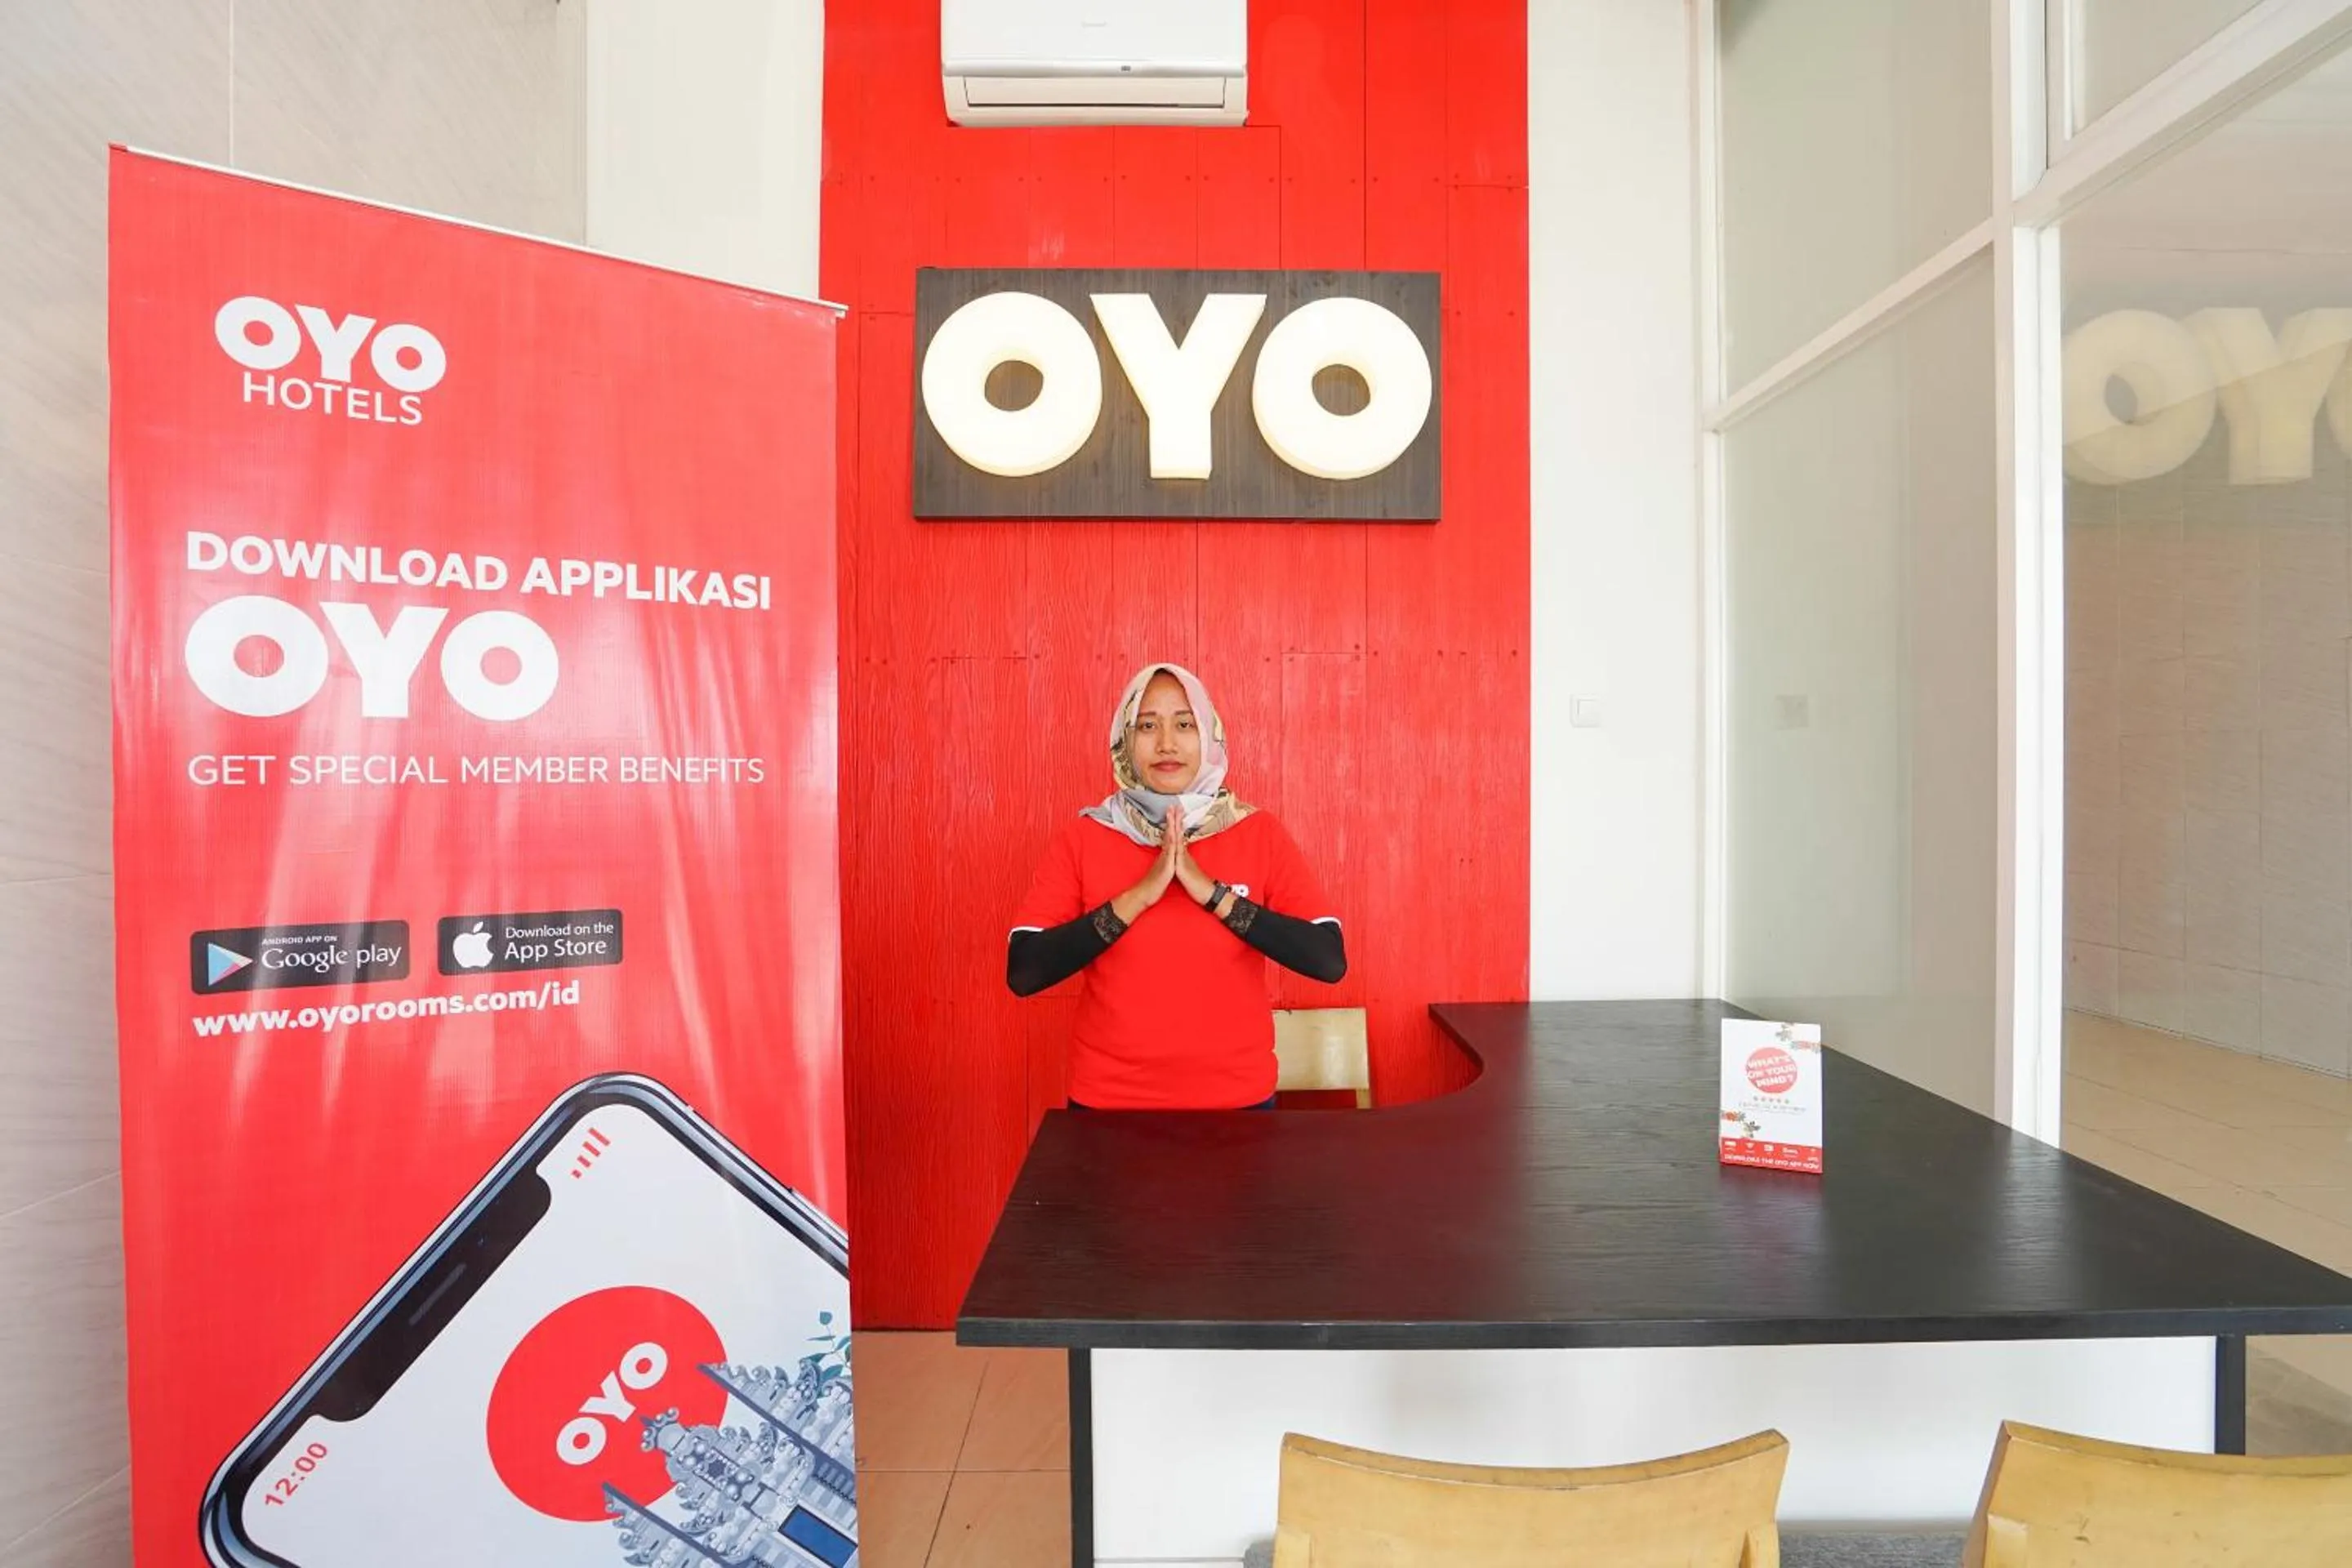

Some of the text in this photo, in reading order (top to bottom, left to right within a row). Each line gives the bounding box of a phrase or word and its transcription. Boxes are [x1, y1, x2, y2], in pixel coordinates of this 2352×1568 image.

[214, 296, 447, 393] OYO
[243, 371, 423, 425] HOTELS
[921, 291, 1432, 480] OYO
[187, 531, 771, 610] DOWNLOAD APPLIKASI
[185, 595, 559, 722] OYO
[188, 755, 764, 786] GET SPECIAL MEMBER BENEFITS
[261, 936, 303, 946] ANDROID
[305, 935, 322, 944] APP
[504, 938, 608, 964] App Store
[506, 921, 614, 938] Download on the
[261, 944, 402, 973] Google play
[193, 981, 580, 1037] www.oyorooms.com/id
[1765, 1064, 1796, 1076] YOUR
[555, 1341, 668, 1466] OYO
[265, 1442, 327, 1506] 12:00
